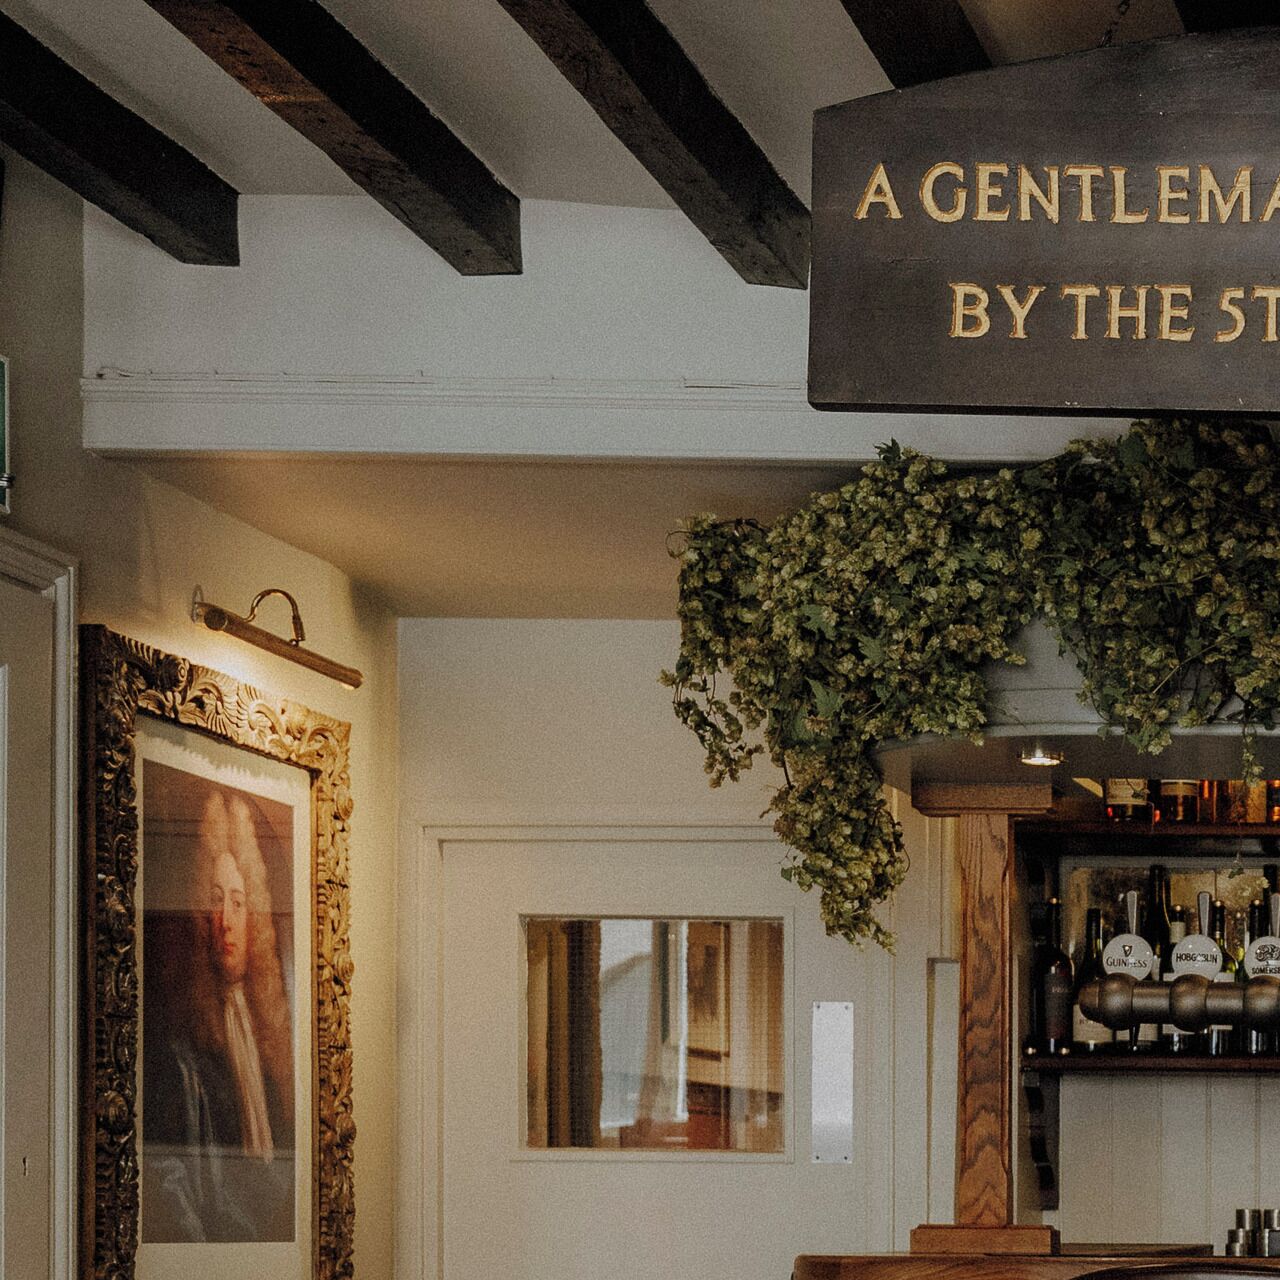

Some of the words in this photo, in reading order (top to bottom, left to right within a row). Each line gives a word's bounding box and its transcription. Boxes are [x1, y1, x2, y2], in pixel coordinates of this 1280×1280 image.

[854, 162, 904, 221] A
[948, 281, 1046, 339] BY
[1059, 283, 1196, 342] THE
